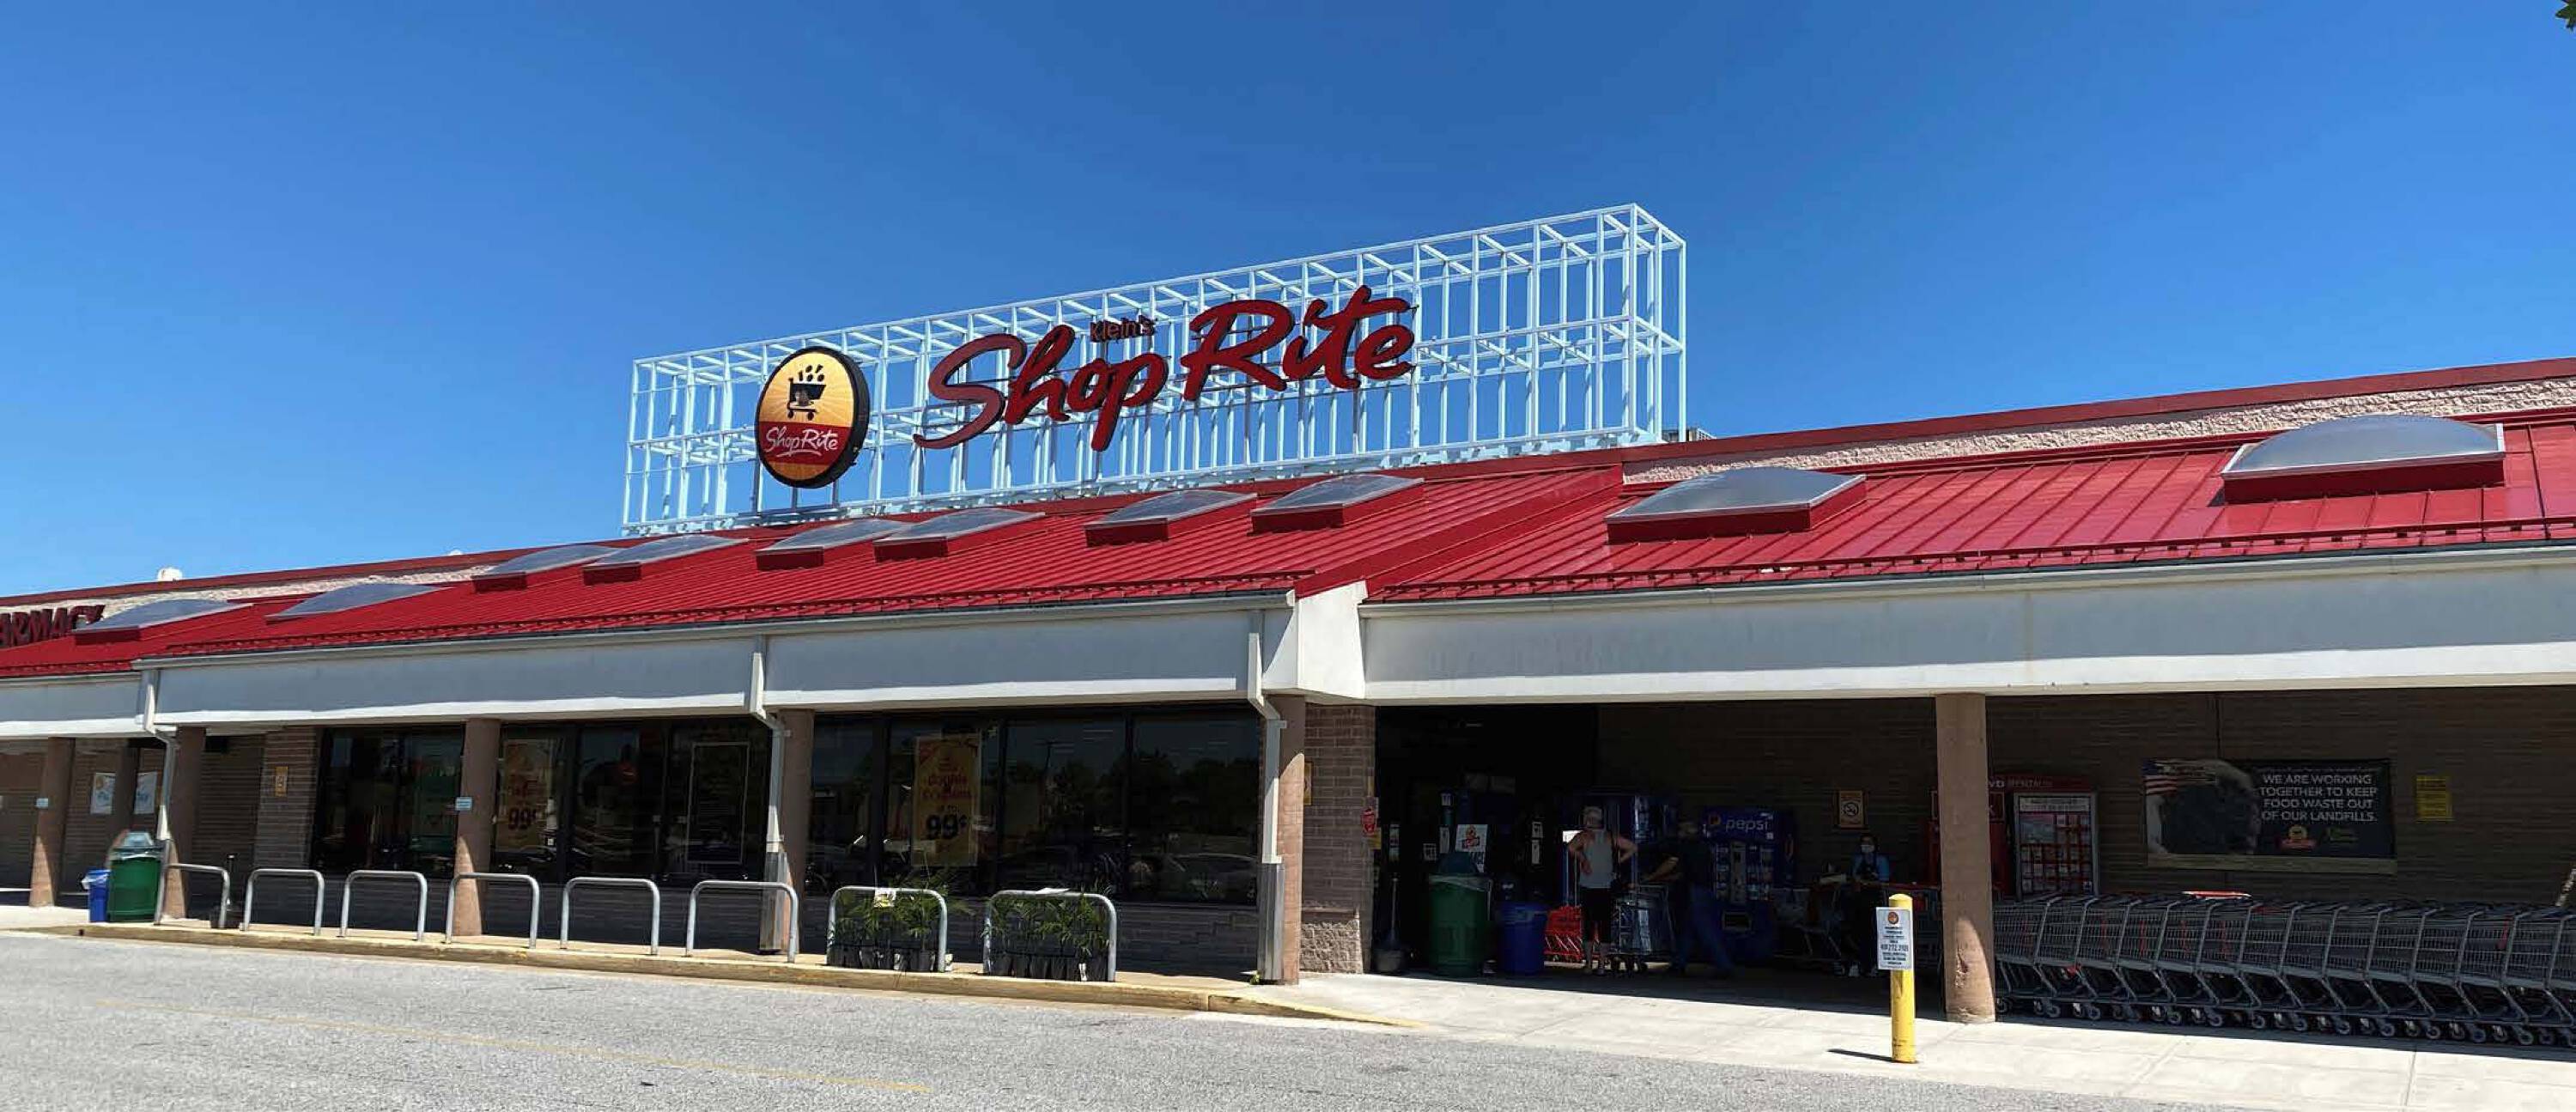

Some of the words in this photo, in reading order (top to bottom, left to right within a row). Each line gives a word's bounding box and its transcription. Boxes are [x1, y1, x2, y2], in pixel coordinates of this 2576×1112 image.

[1091, 315, 1155, 343] Klein's
[2263, 775, 2282, 784] WE
[2286, 775, 2309, 784] ARE
[2311, 775, 2372, 784] WORKING
[2259, 787, 2324, 797] TOGETHER
[2326, 787, 2343, 797] TO
[2346, 787, 2377, 797] KEEP
[2263, 799, 2300, 808] FOOD
[2301, 799, 2344, 808] WASTE
[2348, 799, 2373, 809] OUT
[2261, 811, 2281, 821] OF
[2281, 811, 2308, 821] OUR
[1726, 818, 1771, 833] pepsi
